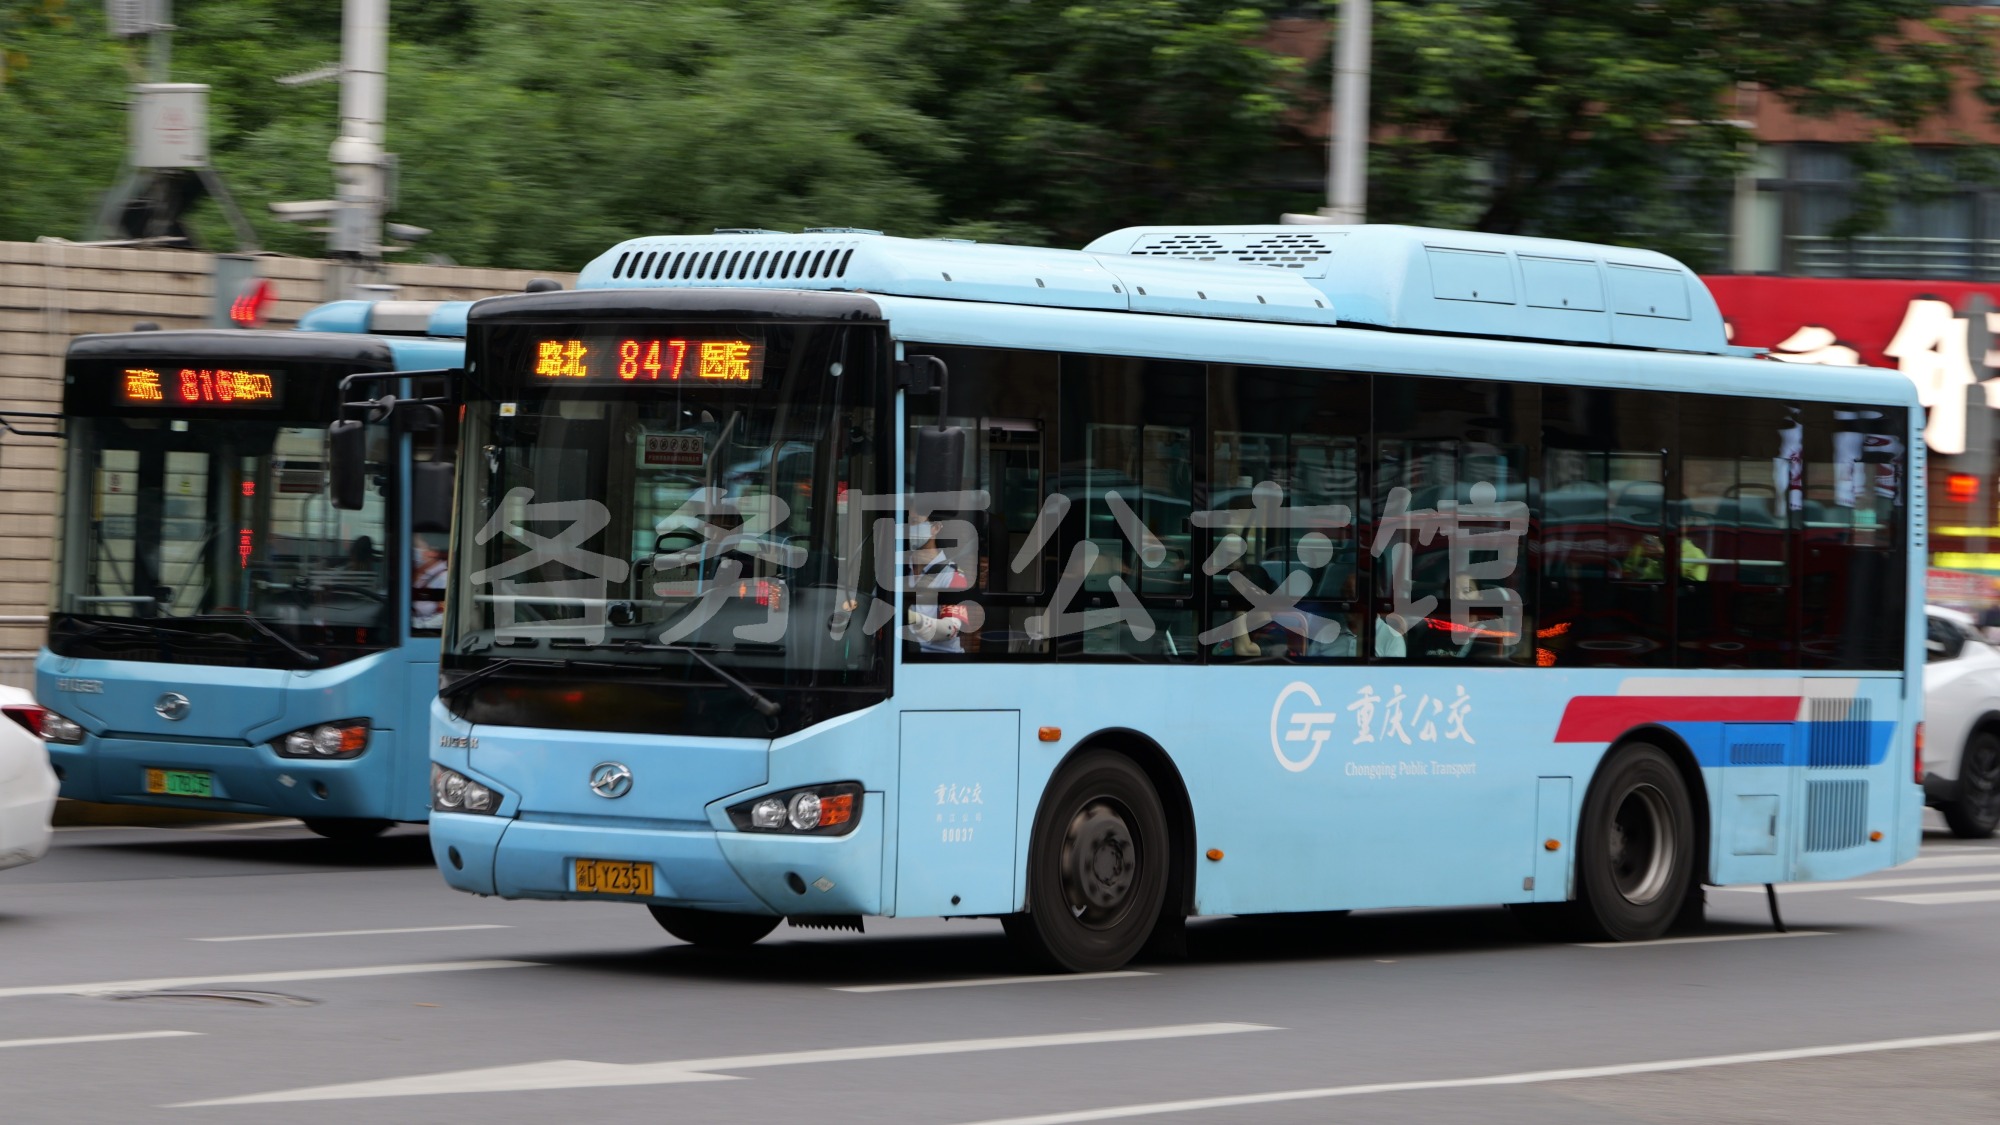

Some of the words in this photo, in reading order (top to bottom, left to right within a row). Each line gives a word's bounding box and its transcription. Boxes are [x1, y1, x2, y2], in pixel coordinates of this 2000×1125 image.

[620, 341, 686, 379] 847
[700, 341, 750, 379] 医院
[1347, 685, 1476, 745] 重庆公交
[1345, 761, 1397, 779] Chongqing
[1399, 761, 1428, 776] Public
[1430, 761, 1476, 778] Transport
